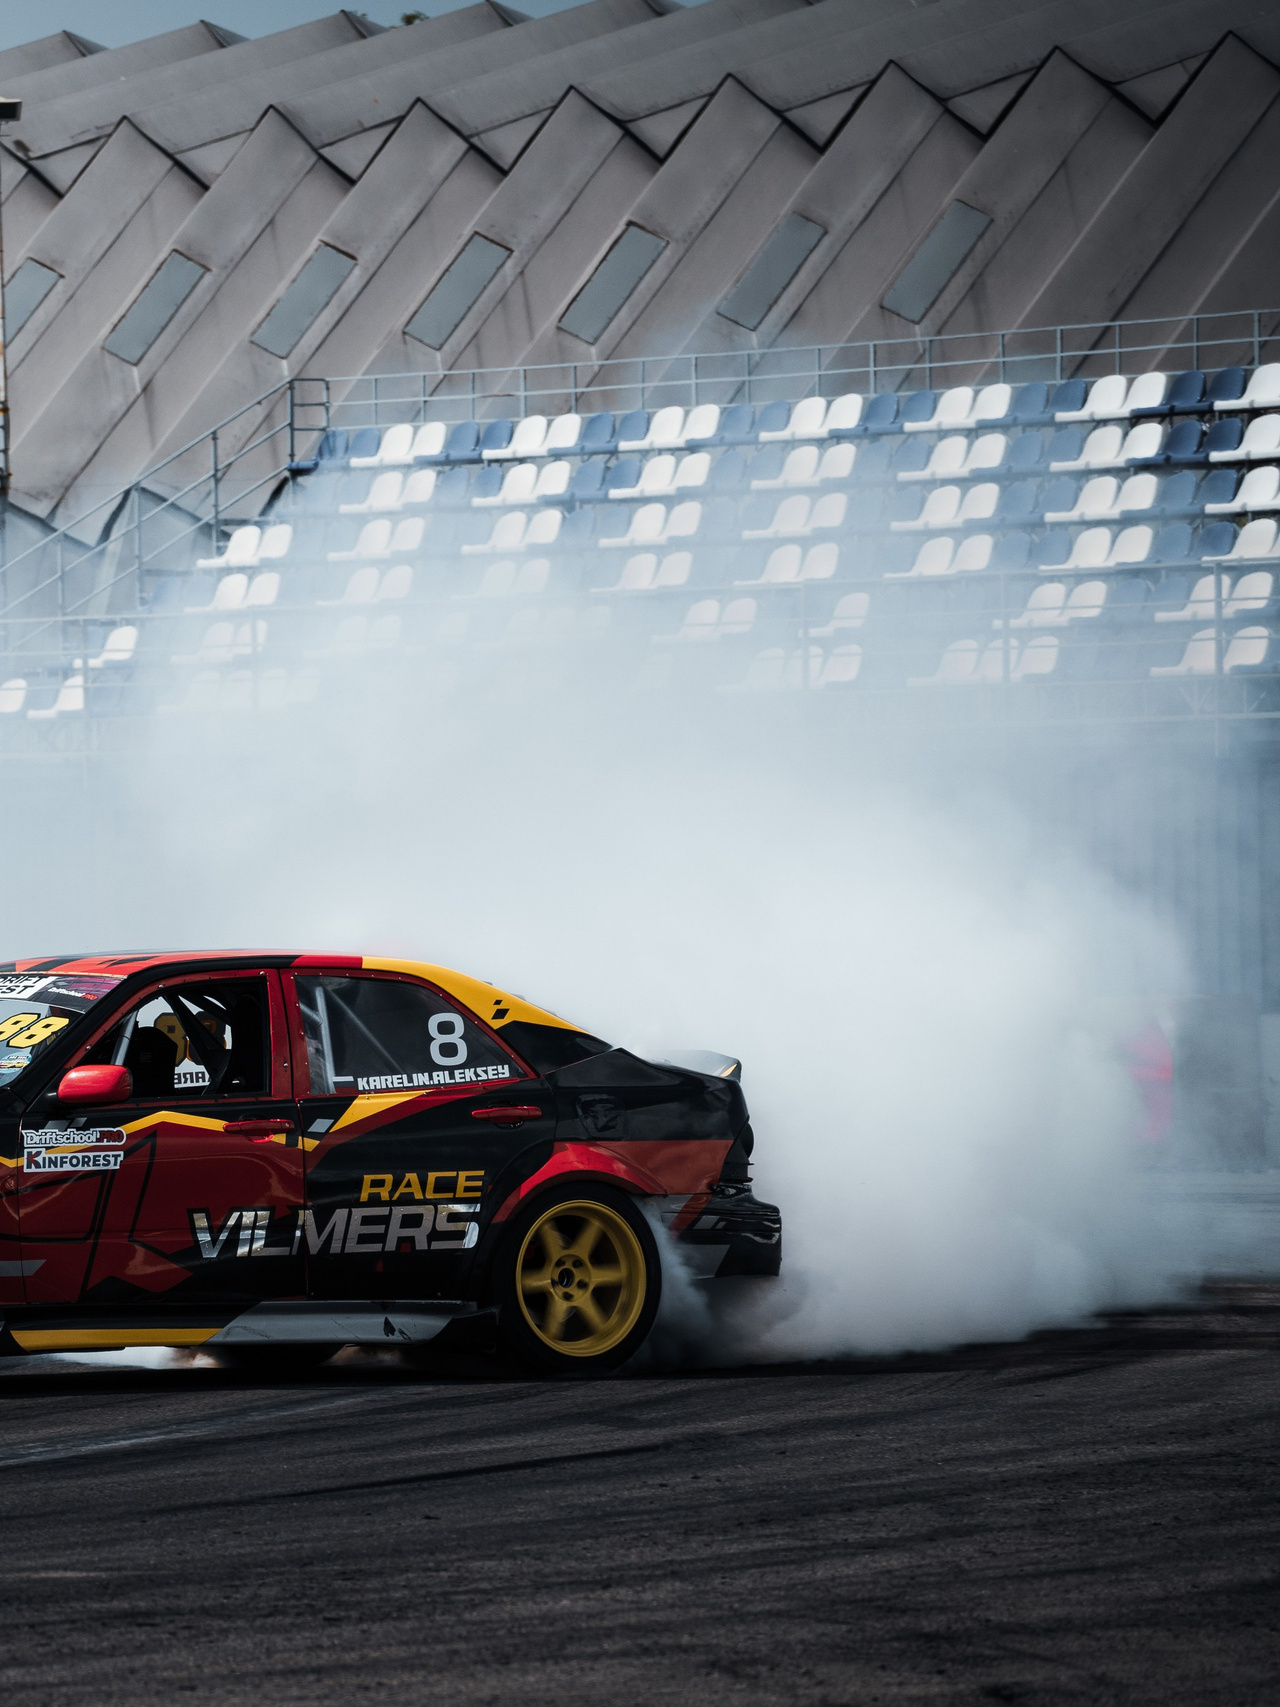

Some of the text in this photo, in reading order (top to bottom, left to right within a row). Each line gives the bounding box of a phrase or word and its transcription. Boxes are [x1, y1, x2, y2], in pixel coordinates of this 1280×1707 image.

[427, 1012, 468, 1067] 8
[357, 1064, 510, 1091] KARELIN.ALEKSEY
[25, 1150, 122, 1170] KINFOREST
[359, 1170, 485, 1202] RACE
[193, 1203, 481, 1258] VILMERS
